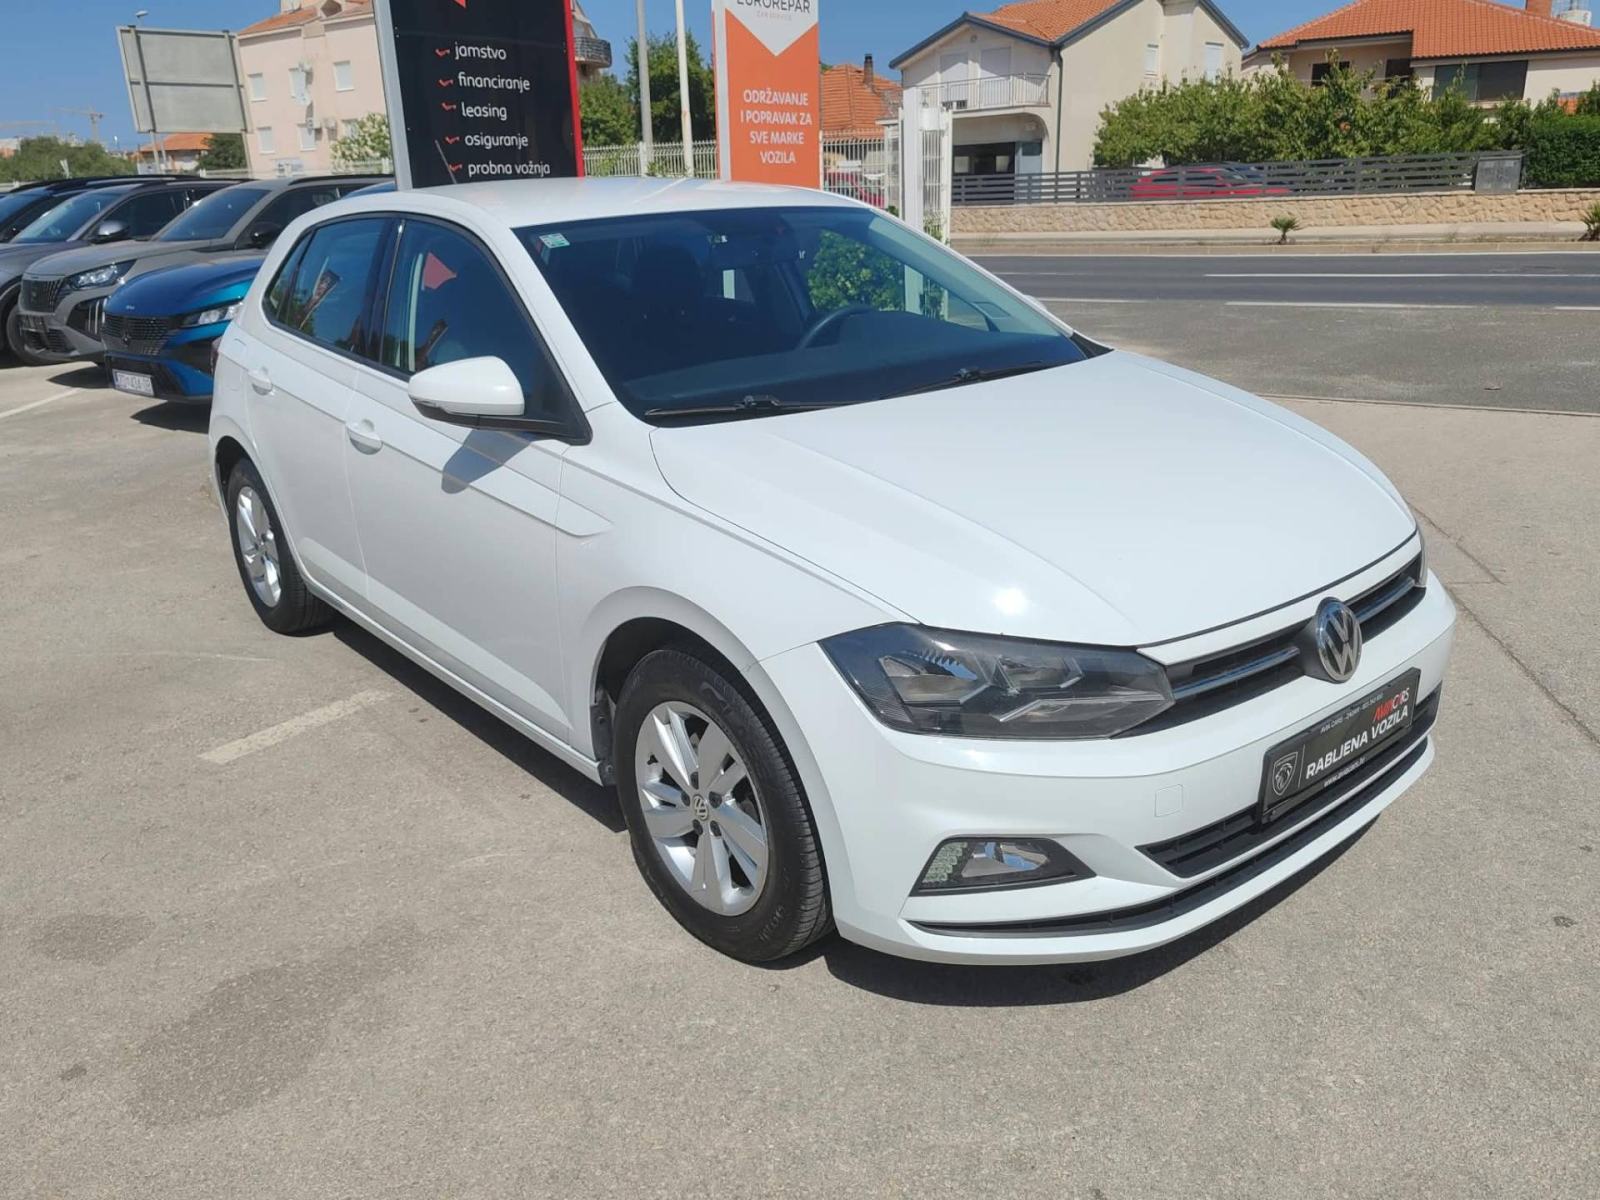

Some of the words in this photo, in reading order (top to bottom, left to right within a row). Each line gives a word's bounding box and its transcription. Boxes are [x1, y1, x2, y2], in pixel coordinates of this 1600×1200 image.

[454, 41, 507, 60] jamstvo
[458, 71, 531, 93] financiranje
[743, 88, 809, 106] ODRŽAVANJE
[461, 101, 508, 121] leasing
[740, 110, 744, 123] I
[746, 110, 798, 125] POPRAVAK
[799, 112, 812, 126] ZA
[464, 132, 529, 150] osiguranje
[750, 130, 769, 144] SVE
[770, 131, 804, 145] MARKE
[760, 150, 796, 164] VOZILA
[468, 161, 513, 178] probna
[514, 160, 551, 178] vožnja
[1305, 731, 1368, 780] RABLJENA
[1371, 704, 1408, 740] VOZILA
